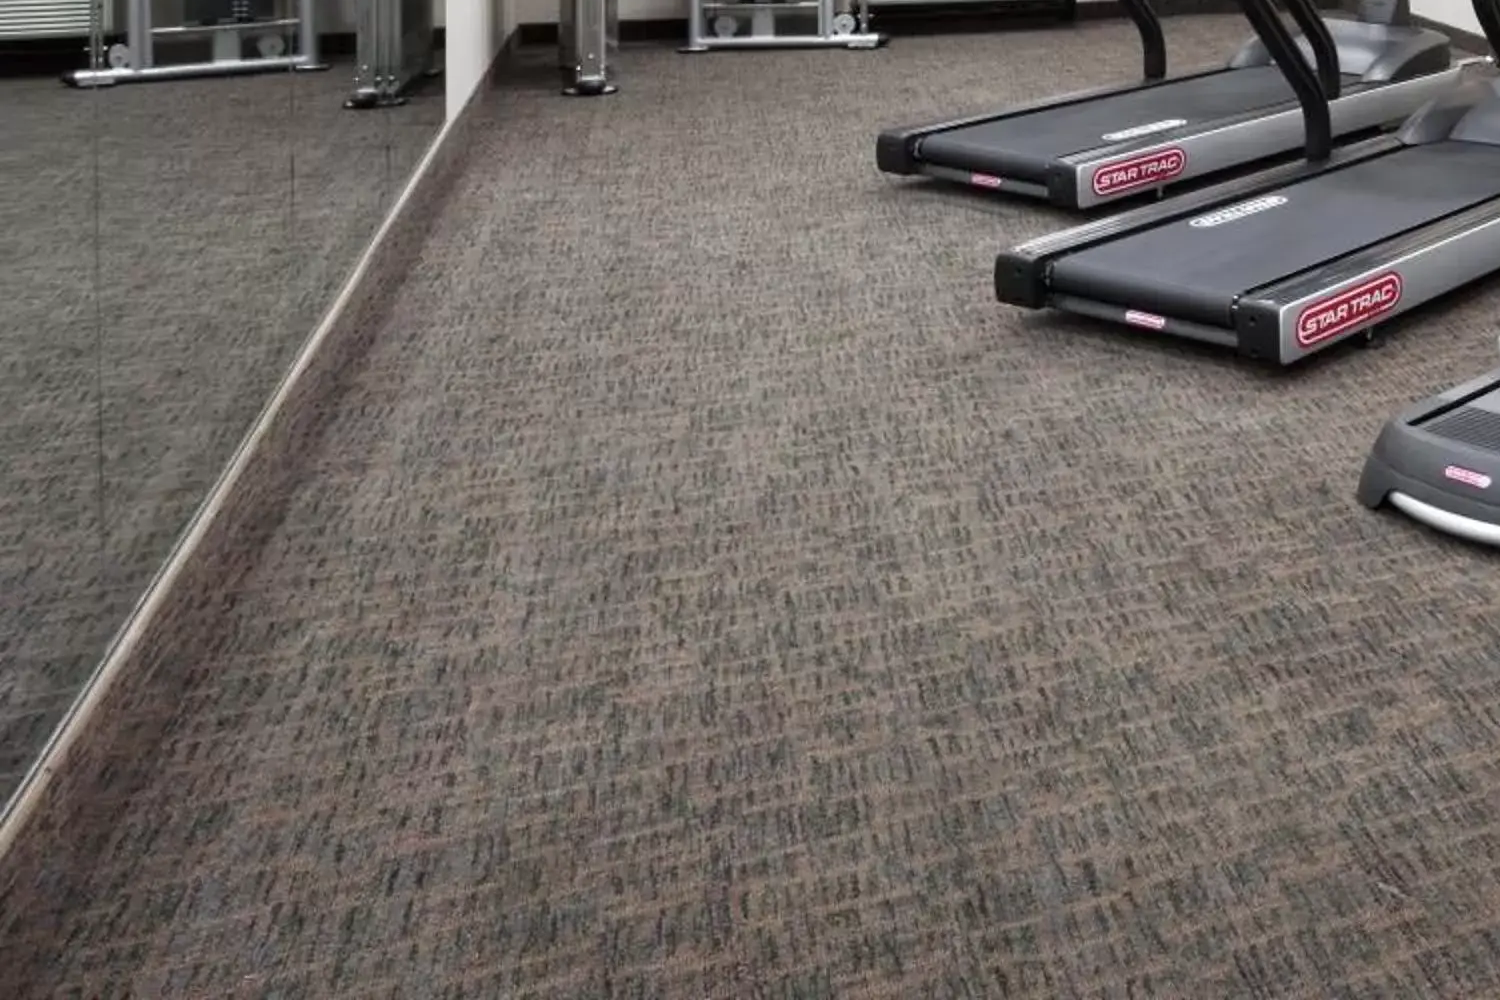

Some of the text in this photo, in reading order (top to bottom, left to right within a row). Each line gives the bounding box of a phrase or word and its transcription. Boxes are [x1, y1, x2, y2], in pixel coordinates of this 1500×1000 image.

[1098, 155, 1181, 187] STAR TRAC
[1301, 283, 1394, 336] STAR TRAC
